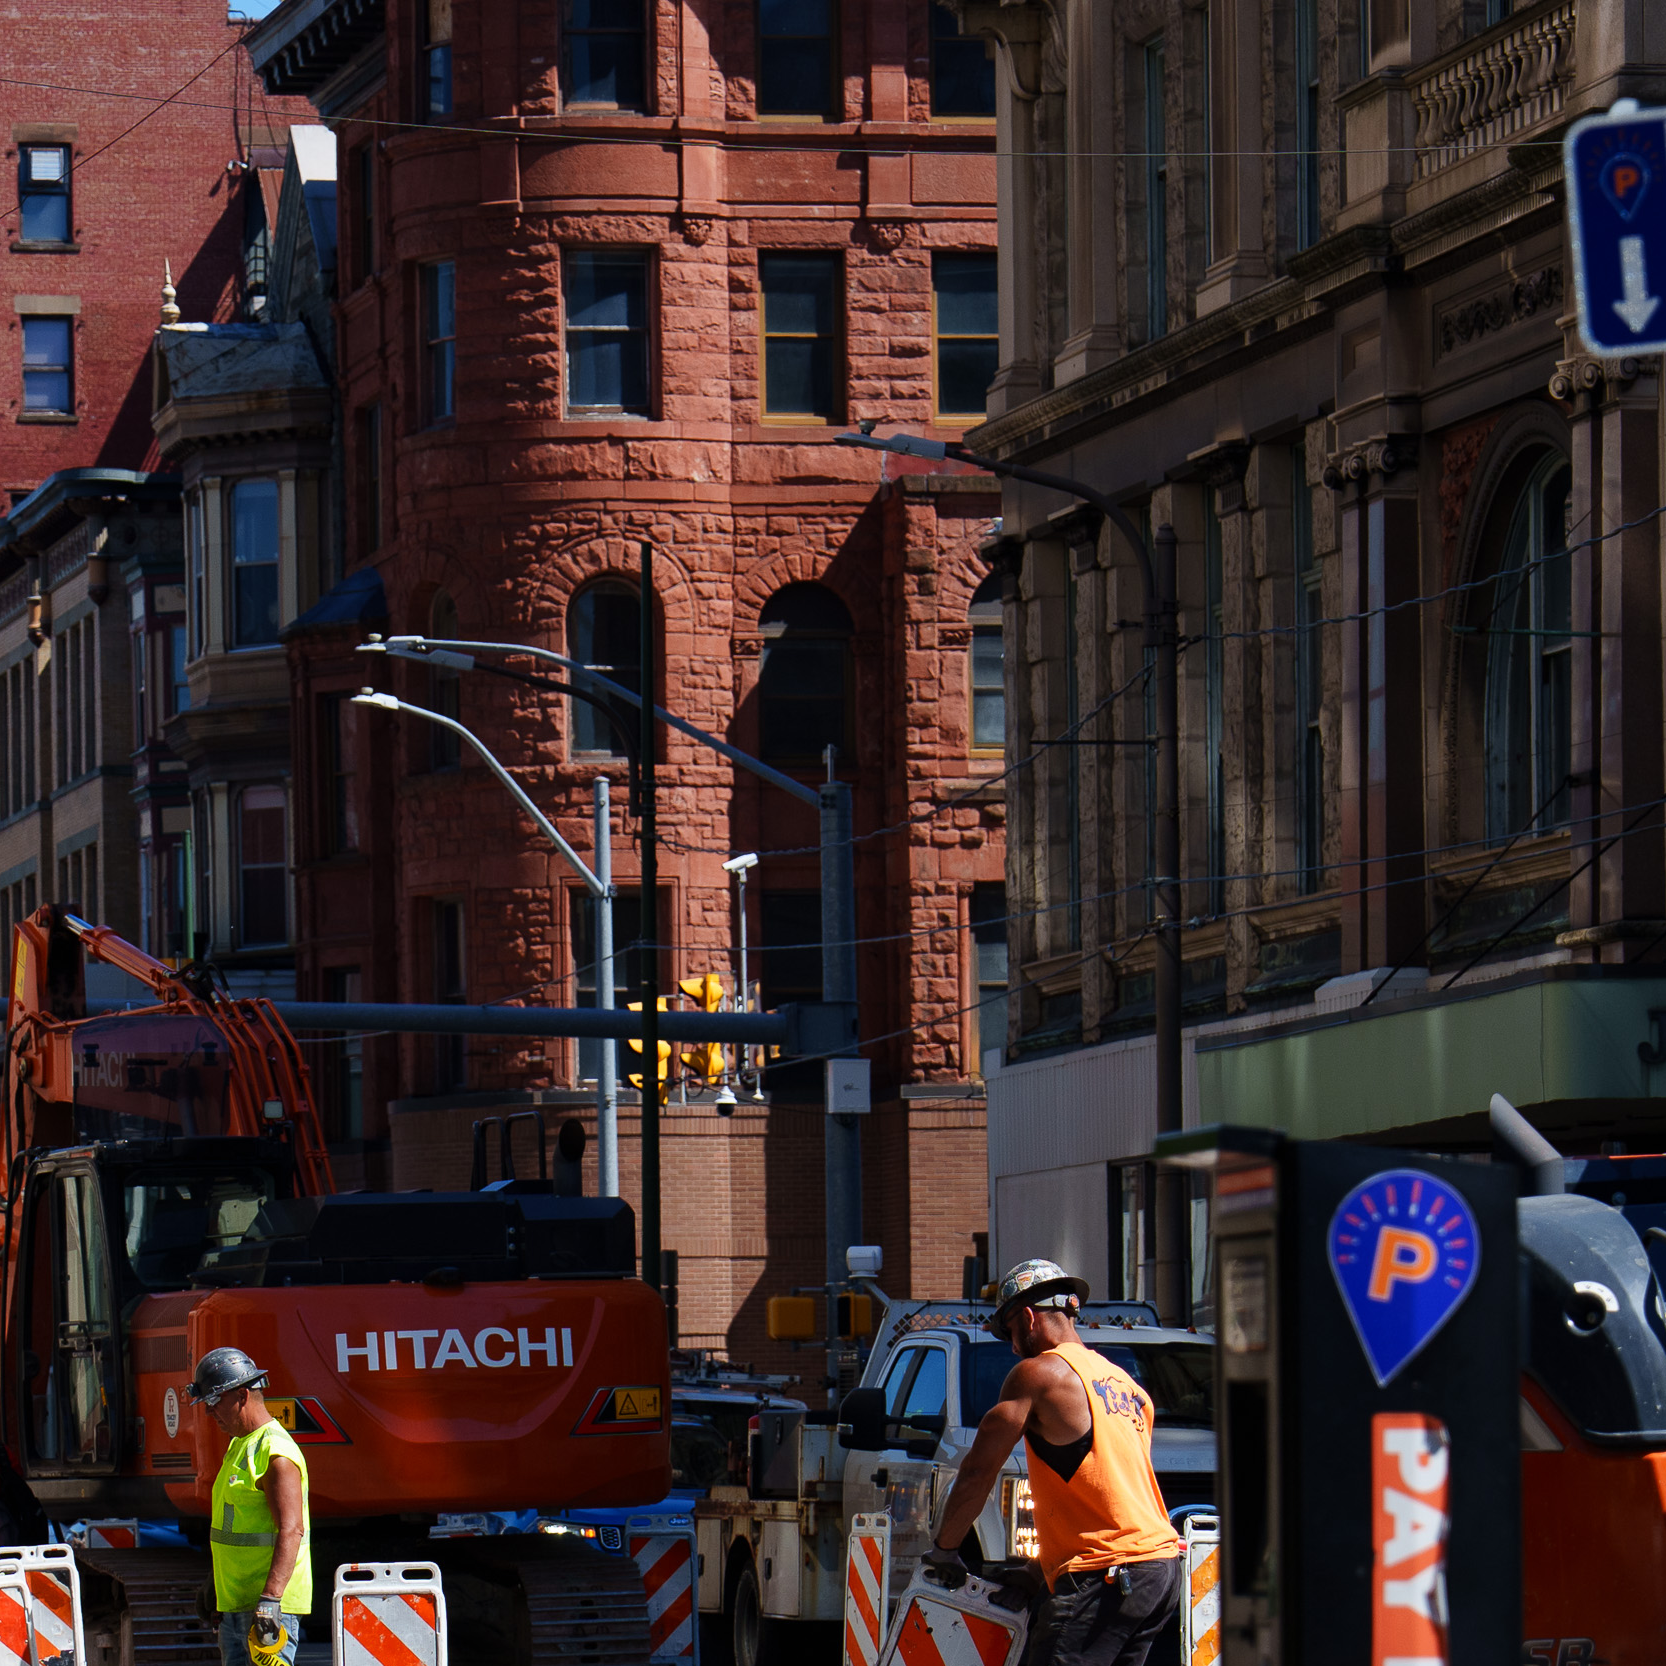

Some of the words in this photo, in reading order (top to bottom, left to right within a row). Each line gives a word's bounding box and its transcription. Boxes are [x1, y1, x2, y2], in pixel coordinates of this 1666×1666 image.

[1368, 1225, 1440, 1303] P
[335, 1326, 575, 1374] HITACHI
[1381, 1427, 1449, 1628] PAY
